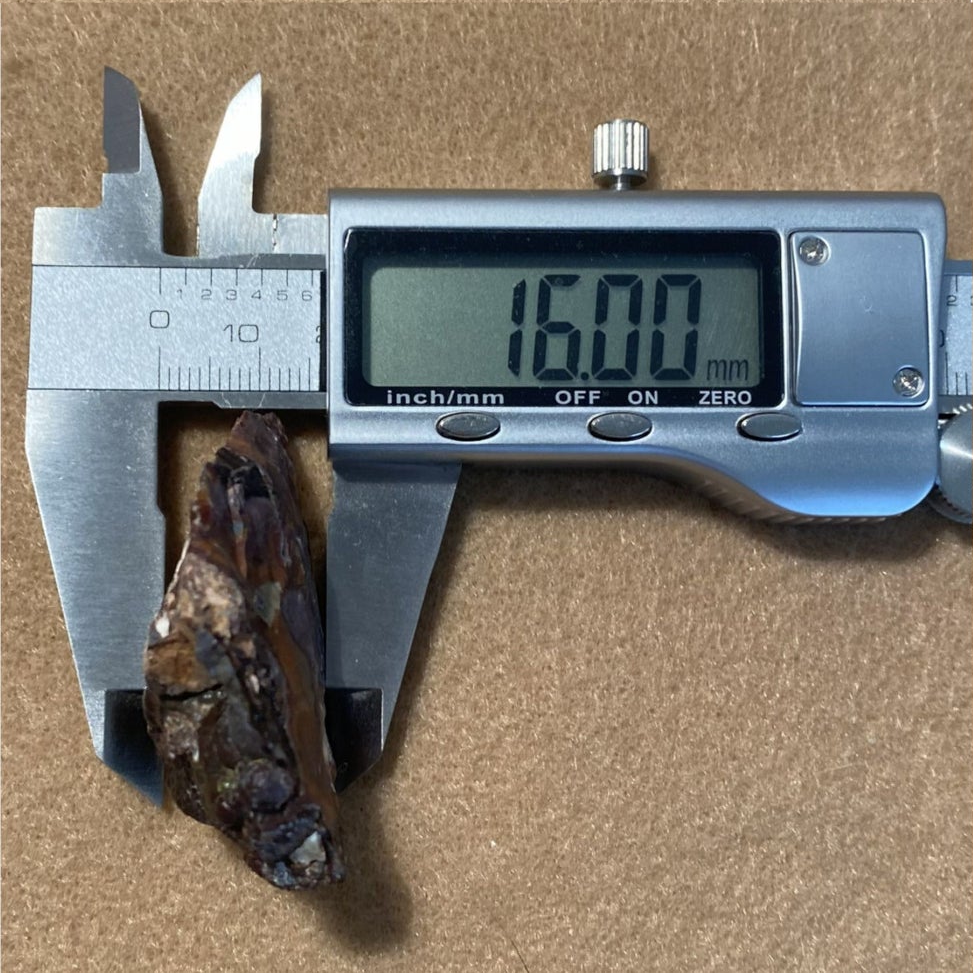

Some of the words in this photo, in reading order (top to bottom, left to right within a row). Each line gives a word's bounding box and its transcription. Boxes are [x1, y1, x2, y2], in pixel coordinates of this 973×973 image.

[177, 288, 183, 300] 1
[201, 289, 212, 301] 2
[225, 289, 237, 301] 3
[251, 289, 262, 301] 4
[276, 289, 288, 301] 5
[301, 290, 313, 302] 6
[149, 310, 170, 329] 0
[223, 324, 259, 343] 10
[507, 274, 702, 381] 16.00
[707, 356, 749, 381] mm
[386, 390, 505, 406] inch/mm
[555, 391, 601, 405] OFF
[628, 391, 660, 405] ON
[699, 391, 753, 405] ZERO
